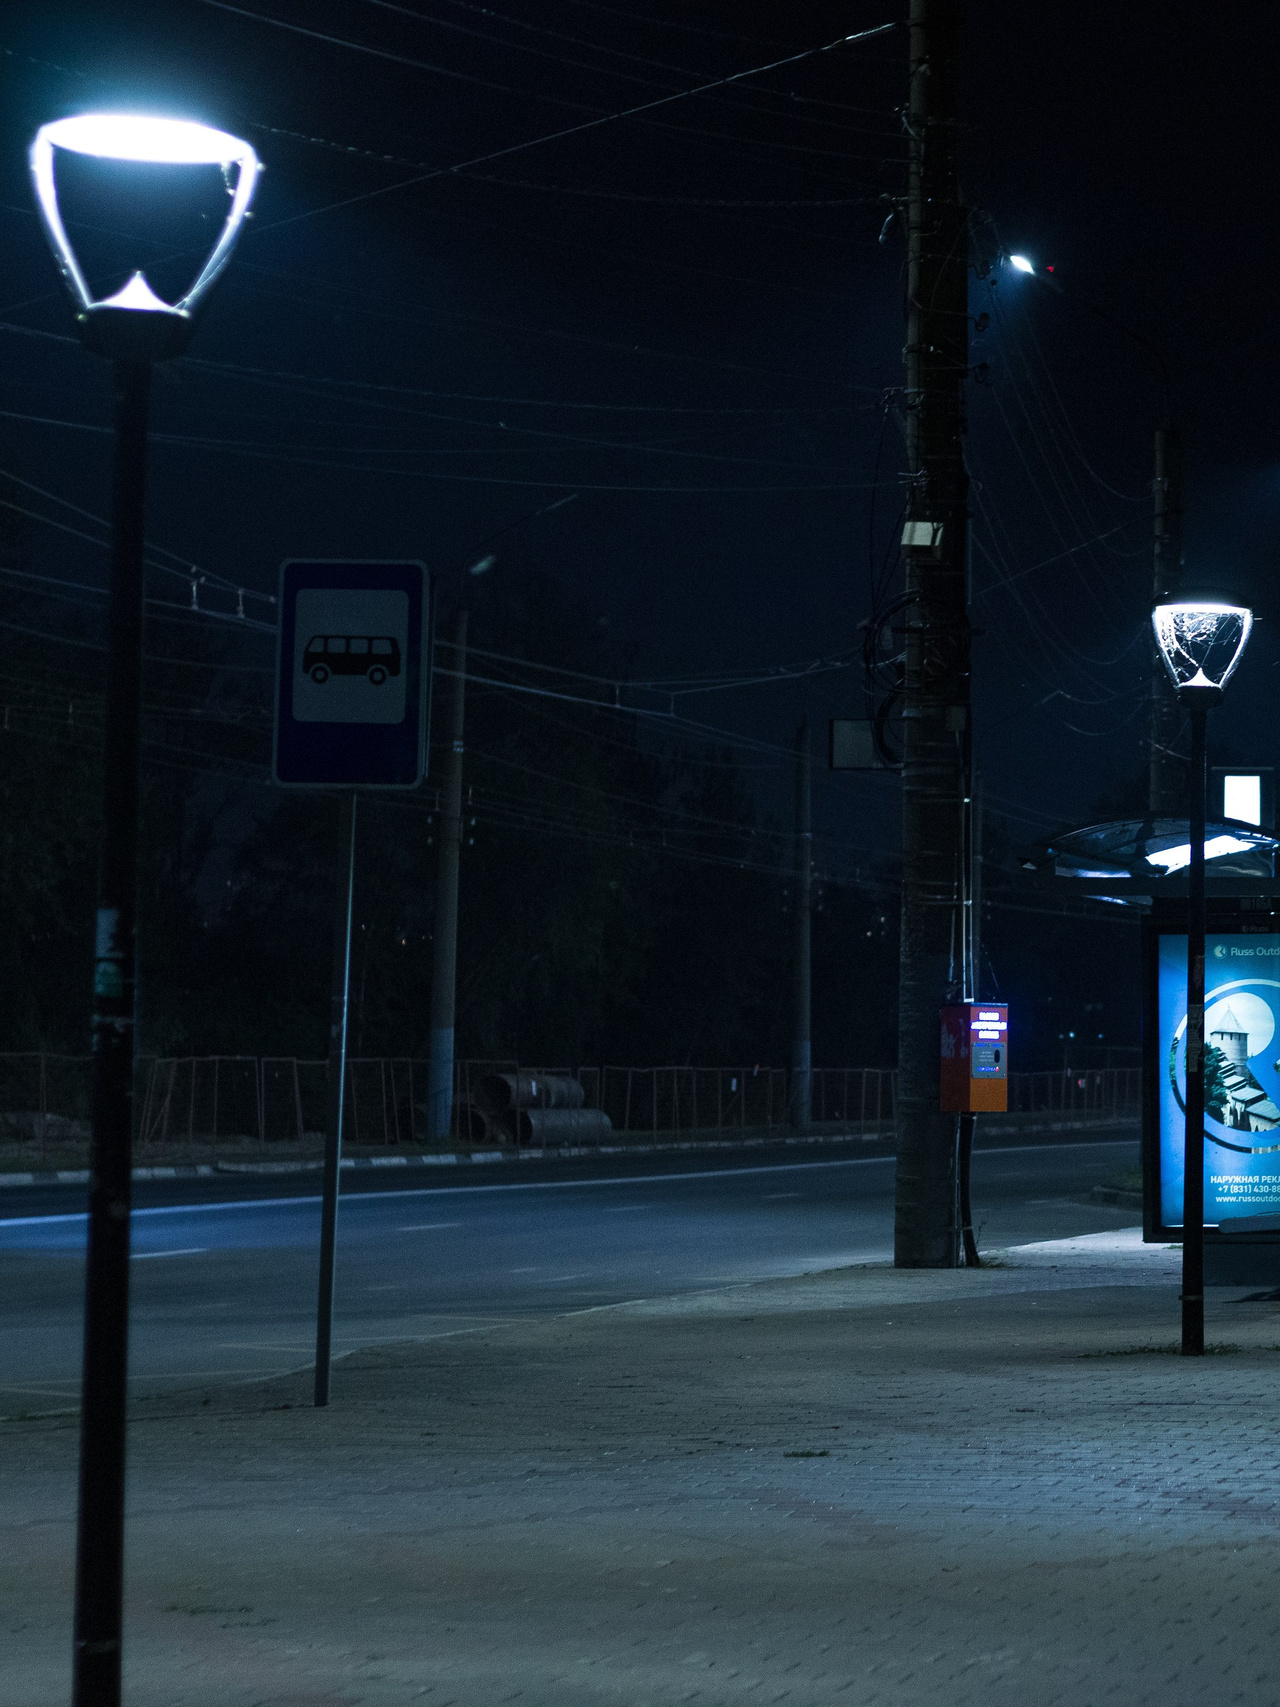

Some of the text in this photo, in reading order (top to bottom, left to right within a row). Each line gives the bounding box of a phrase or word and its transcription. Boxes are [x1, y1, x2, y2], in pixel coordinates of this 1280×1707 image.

[1230, 947, 1254, 956] Russ
[1210, 1175, 1260, 1184] НАРУЖНАЯ
[1217, 1185, 1229, 1193] +7
[1230, 1184, 1252, 1194] (831)
